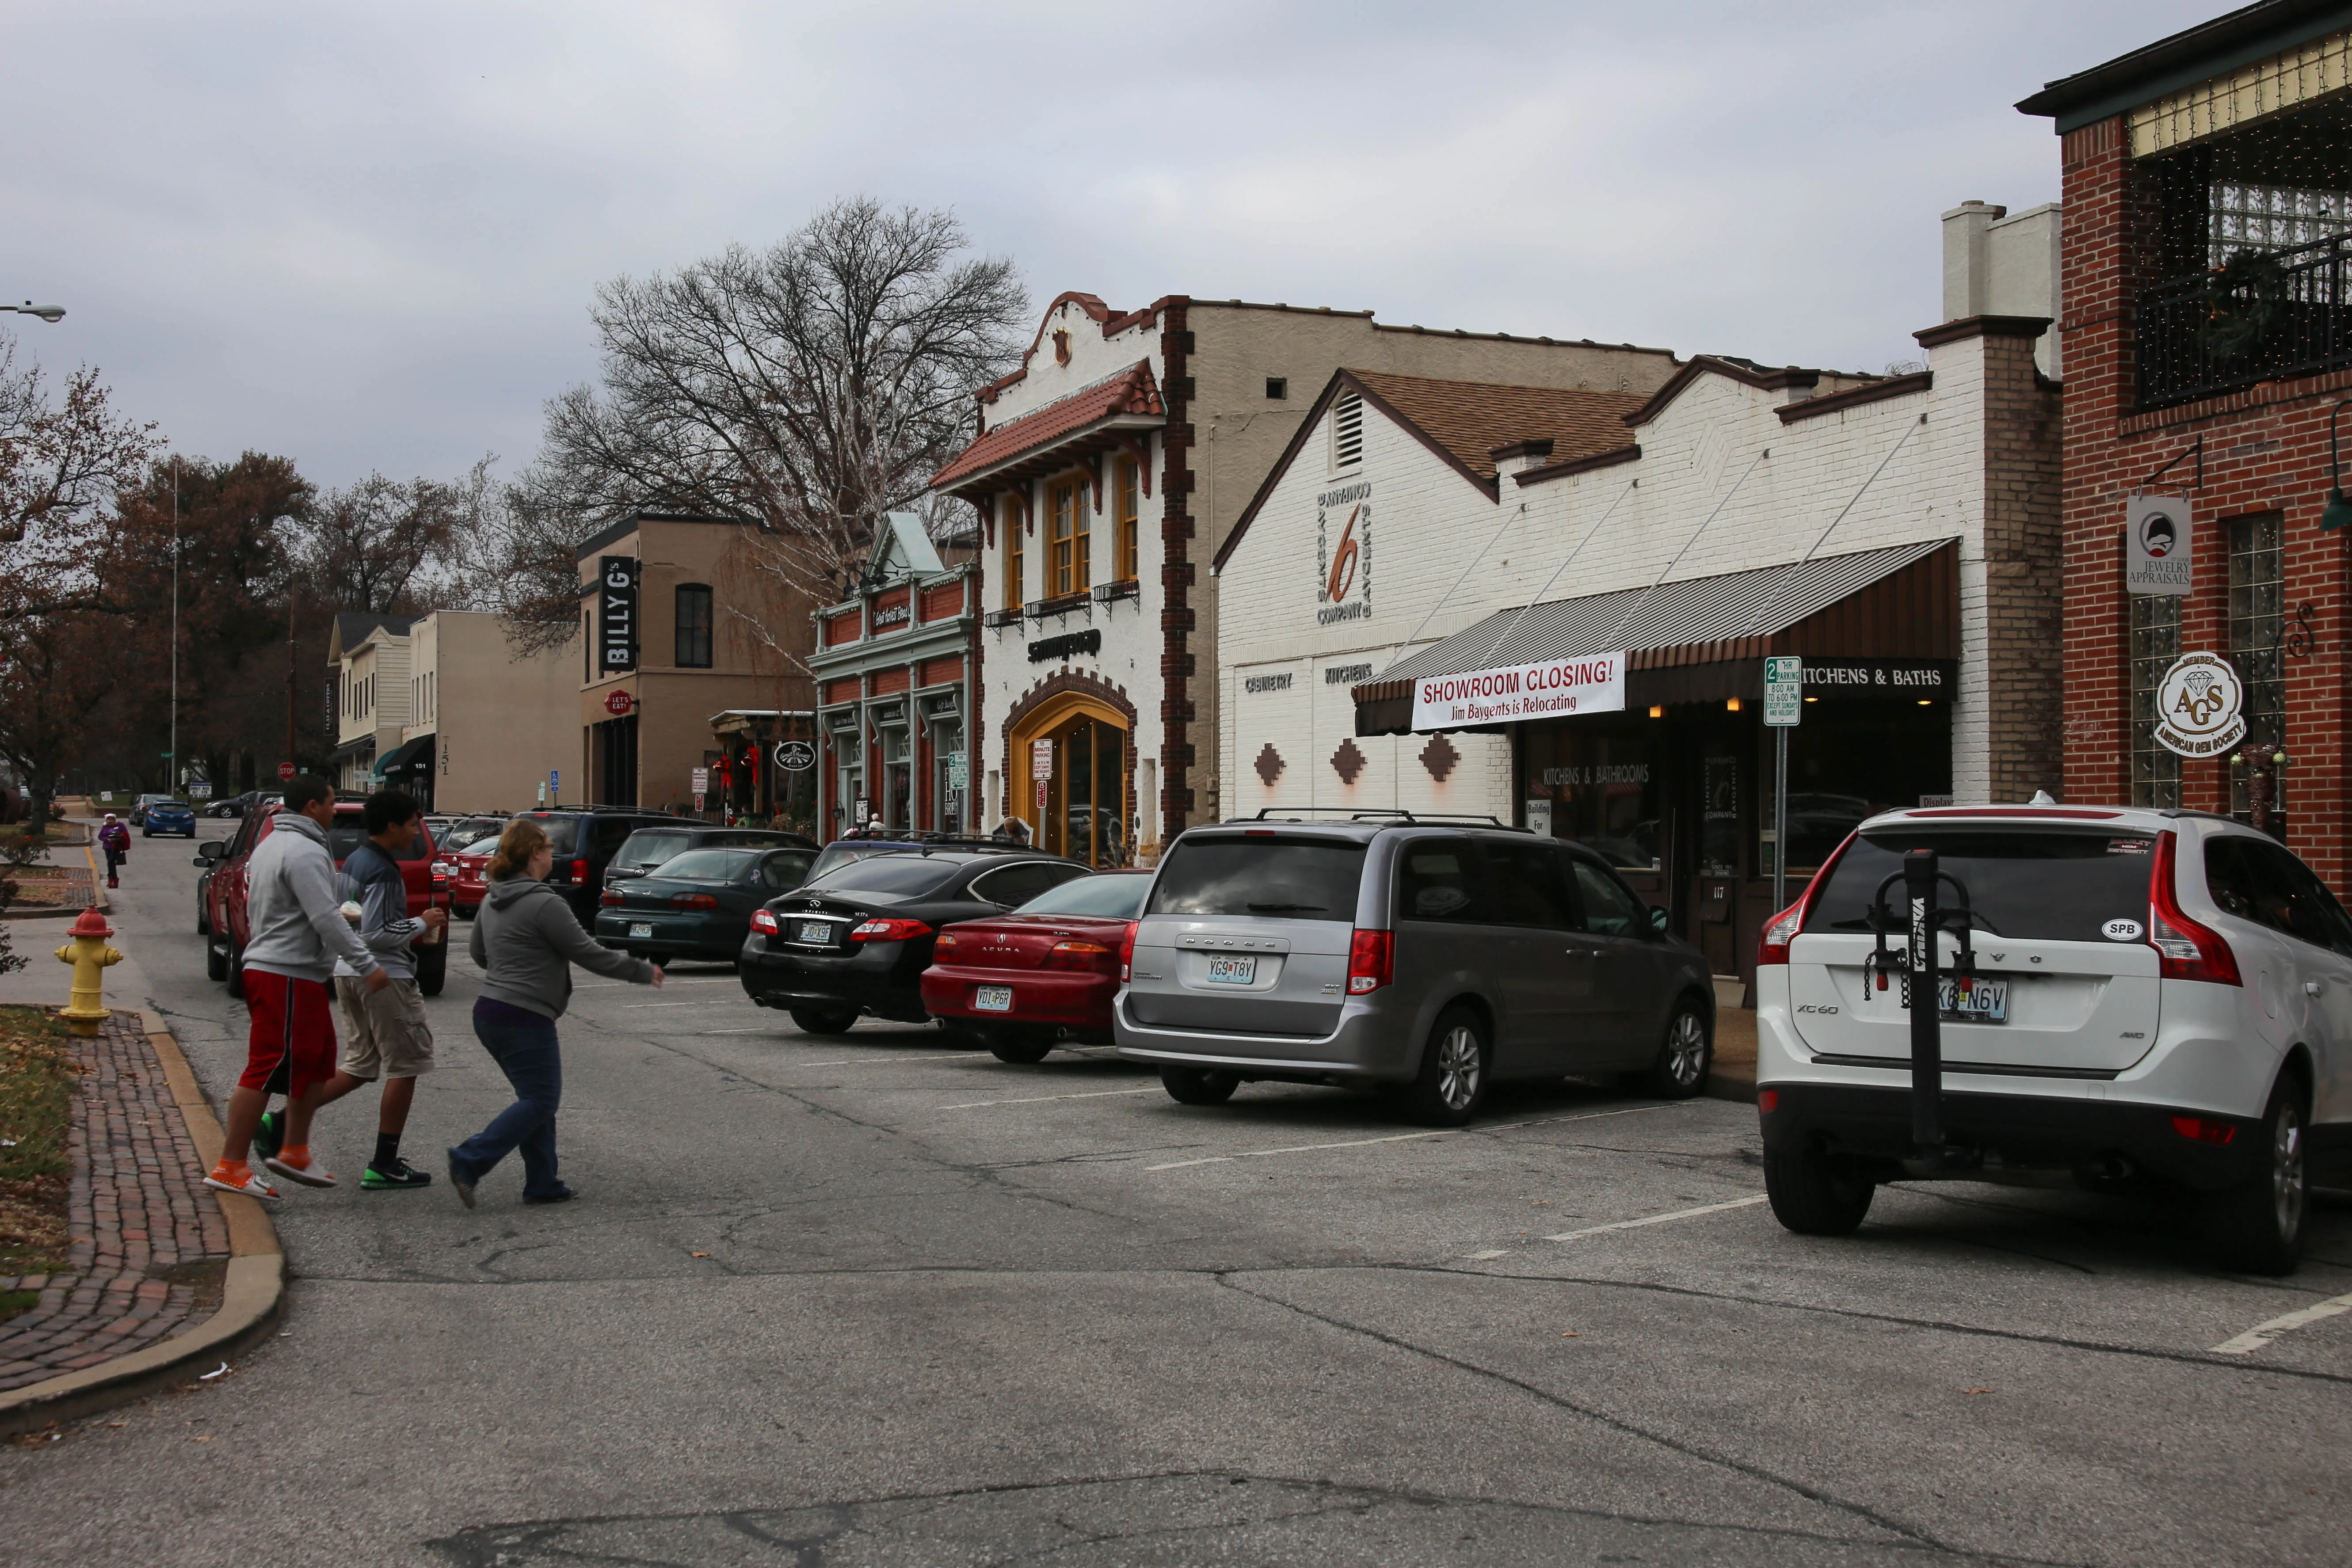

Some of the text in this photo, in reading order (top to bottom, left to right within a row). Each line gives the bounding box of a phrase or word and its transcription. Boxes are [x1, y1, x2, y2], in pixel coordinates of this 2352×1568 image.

[1326, 481, 1370, 508] COMPANY
[1362, 504, 1370, 617] BAYGENTS
[2145, 561, 2190, 573] JEWELRY
[2129, 572, 2189, 584] APPRAISALS
[876, 610, 885, 626] Great
[885, 607, 897, 623] Harvest
[898, 606, 908, 620] Bread
[1317, 602, 1361, 625] COMPANY
[607, 595, 629, 663] BILLY
[1028, 629, 1101, 663] sammysoap
[2183, 655, 2215, 666] MEMBER
[1245, 663, 1372, 693] CABINETRY KITCHENS
[1768, 661, 1792, 679] 2 HR
[1777, 672, 1799, 681] PARKING
[1801, 668, 1941, 685] ITCHENS & BATHS
[1424, 660, 1613, 704] SHOWROOM CLOSING!
[1768, 693, 1774, 702] TO
[2174, 685, 2223, 725] AGS
[1452, 693, 1576, 721] Jim Baygents is Relocating
[2158, 722, 2242, 754] AMERICAN GEM SOCIETY
[796, 751, 811, 760] Harvest
[950, 756, 954, 765] 2
[1544, 764, 1649, 785] KITCHENS & BATHROOMS
[945, 782, 957, 801] HO
[1528, 803, 1550, 815] Building
[1534, 820, 1543, 830] For
[1714, 887, 1724, 898] 117
[2110, 924, 2135, 934] SPB
[1186, 938, 1275, 948] DODGE
[1211, 960, 1252, 977] YG9 T8Y
[995, 992, 1009, 1005] P6R
[1967, 987, 2003, 1010] N6V
